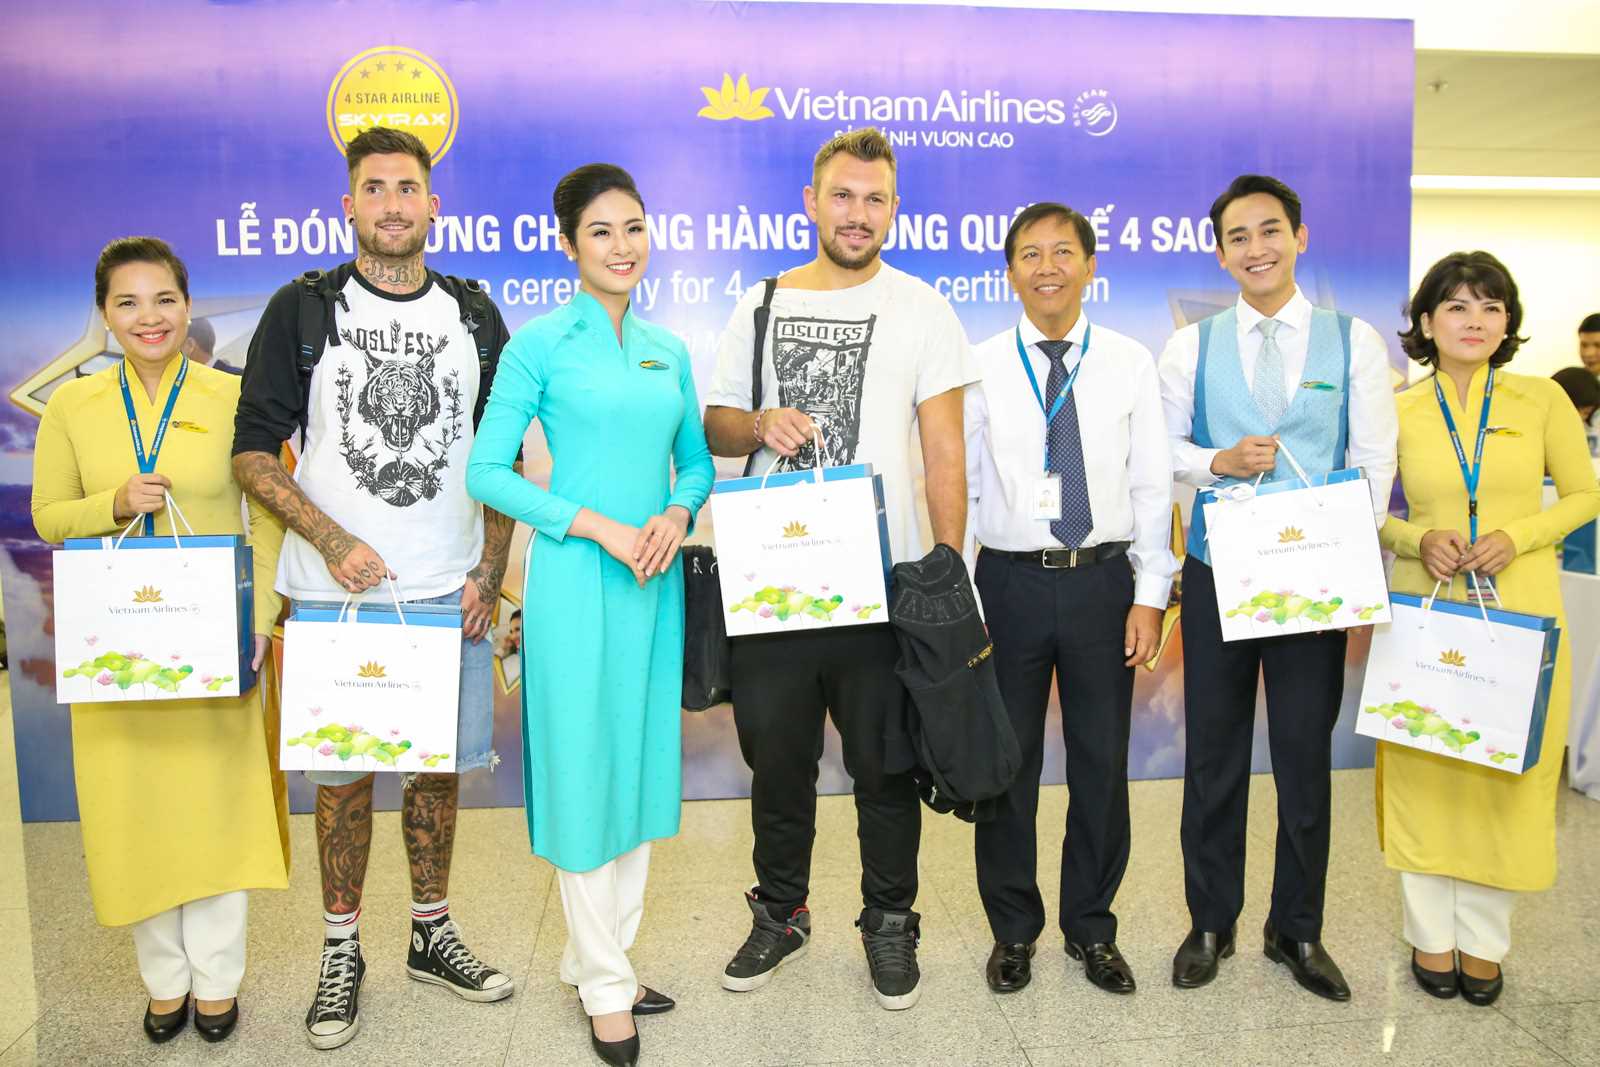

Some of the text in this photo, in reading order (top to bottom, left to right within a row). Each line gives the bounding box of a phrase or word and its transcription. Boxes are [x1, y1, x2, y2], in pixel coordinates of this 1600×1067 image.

[345, 91, 440, 105] 4 STAR AIRLINE
[774, 87, 1066, 125] Vietnam Airlines
[338, 112, 447, 127] SKYTRAX
[977, 132, 1014, 148] CAO
[216, 202, 262, 256] LỄ
[272, 208, 354, 255] ĐÓN
[707, 205, 811, 251] HÀNG
[1119, 216, 1142, 253] 4
[1151, 215, 1218, 254] SAO
[670, 269, 715, 304] for
[782, 323, 829, 341] OSLO
